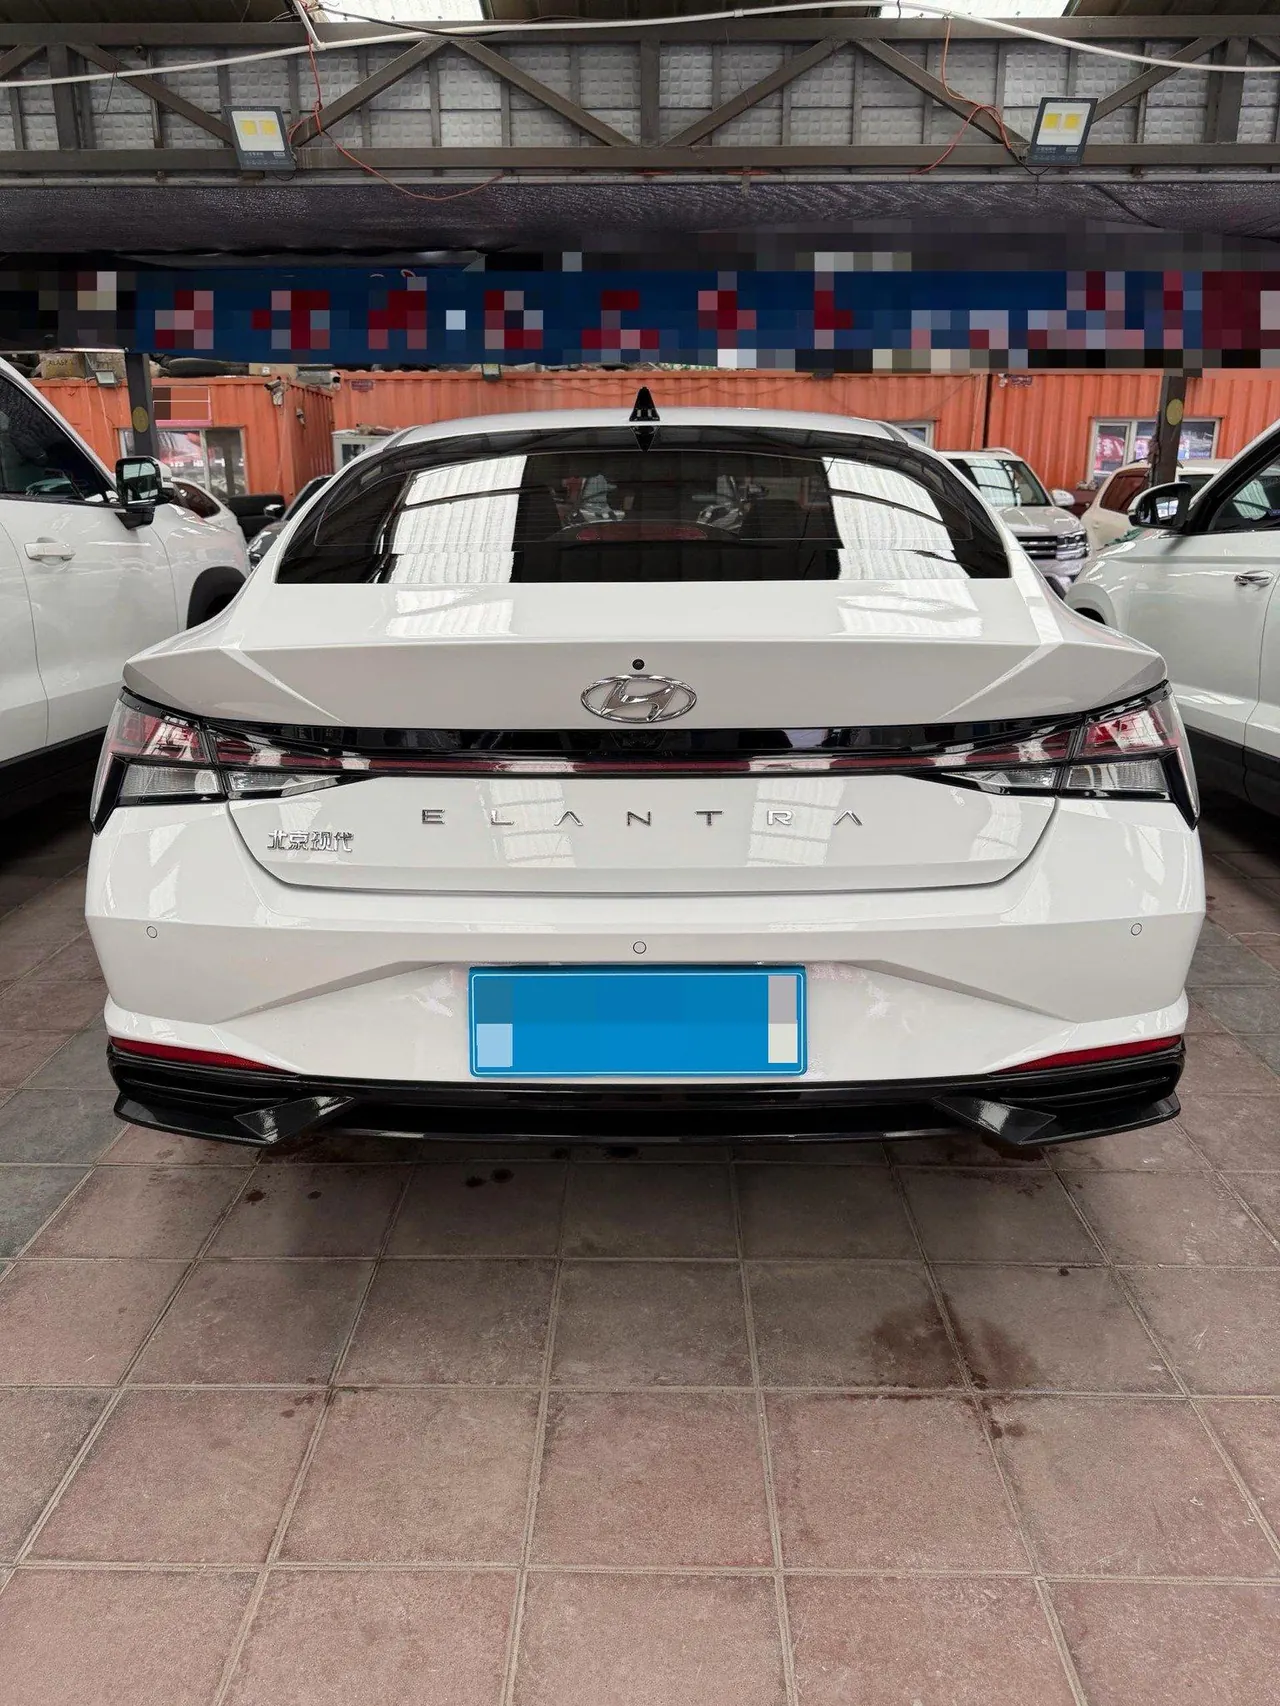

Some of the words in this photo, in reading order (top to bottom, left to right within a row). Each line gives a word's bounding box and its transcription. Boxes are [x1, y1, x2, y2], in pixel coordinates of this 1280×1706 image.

[422, 809, 863, 827] ELANTRA
[266, 829, 354, 852] 北京现代
